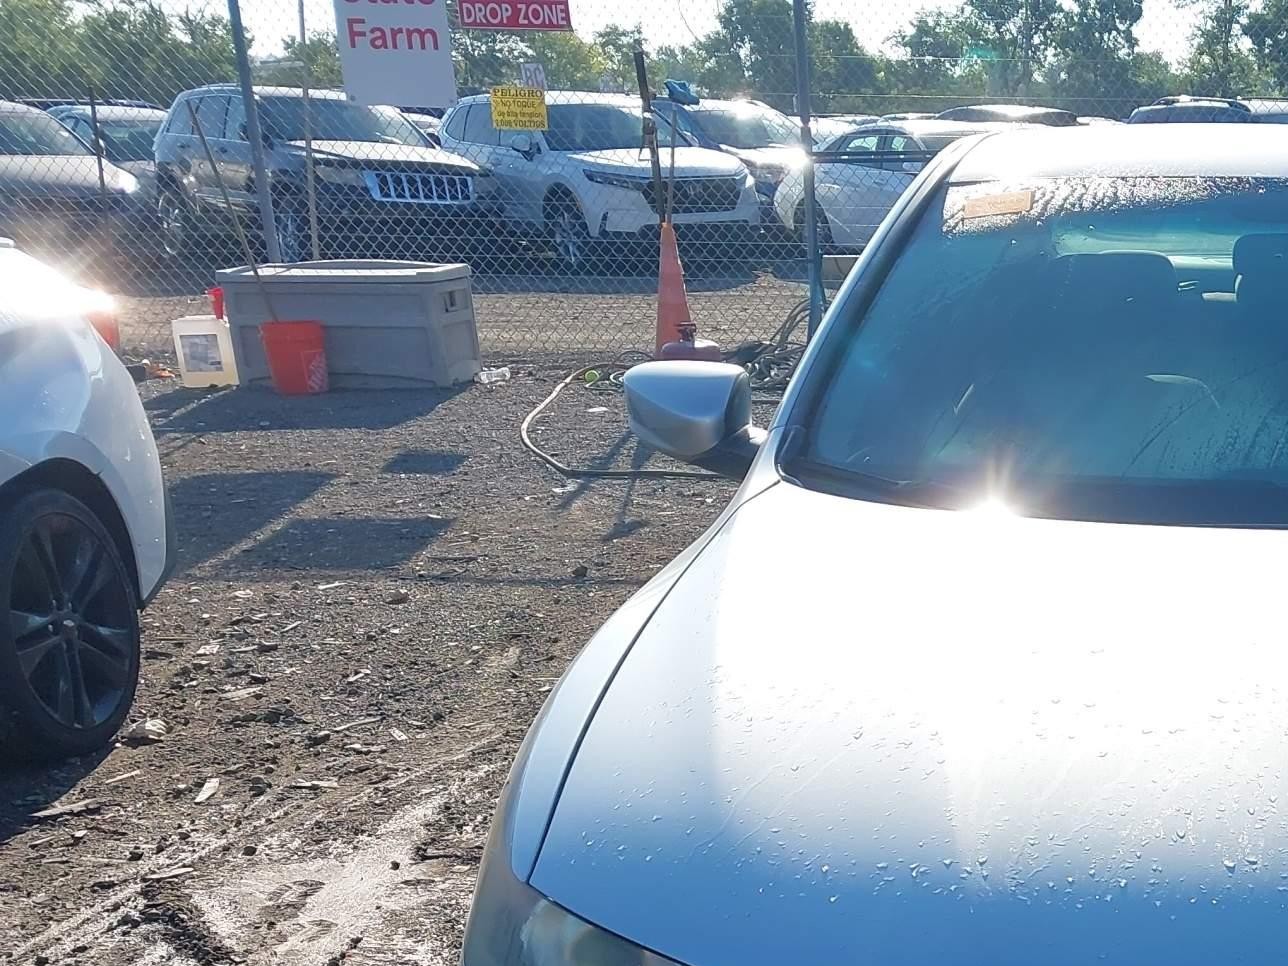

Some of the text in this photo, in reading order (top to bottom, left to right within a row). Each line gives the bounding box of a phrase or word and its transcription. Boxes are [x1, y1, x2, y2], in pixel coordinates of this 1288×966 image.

[462, 3, 567, 25] DROP ZONE
[347, 18, 439, 50] Farm
[493, 88, 543, 98] PELIGRO
[512, 100, 537, 108] TOQUE
